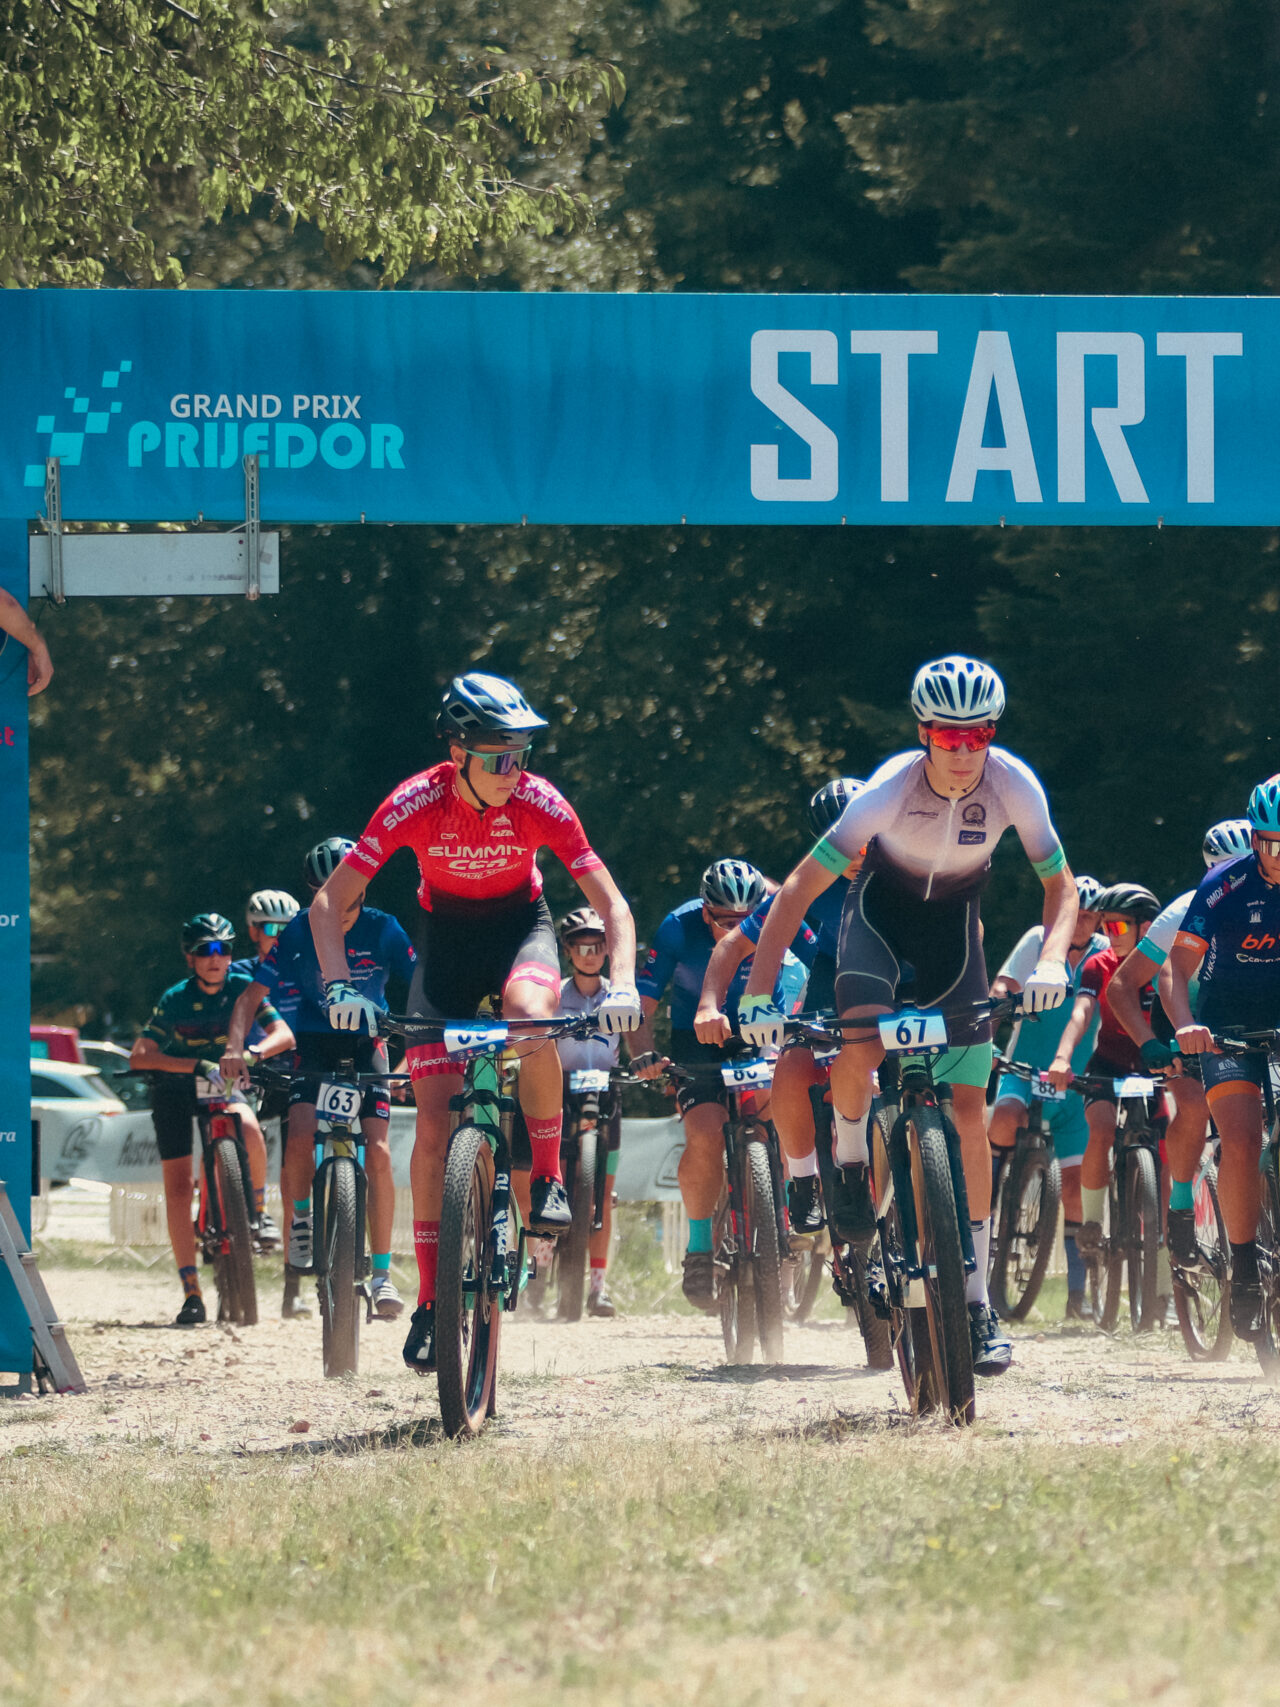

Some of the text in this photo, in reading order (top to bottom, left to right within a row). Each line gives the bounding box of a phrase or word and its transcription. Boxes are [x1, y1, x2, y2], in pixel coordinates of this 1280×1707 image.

[170, 394, 361, 419] GRAND PRIX
[750, 330, 1243, 503] START
[128, 420, 406, 470] PRIJEDOR
[382, 782, 446, 831] SUMMIT
[512, 786, 572, 823] UMMIT
[428, 845, 528, 859] SUMMIT
[1241, 934, 1276, 950] bh
[896, 1018, 927, 1046] 67
[328, 1089, 355, 1113] 63
